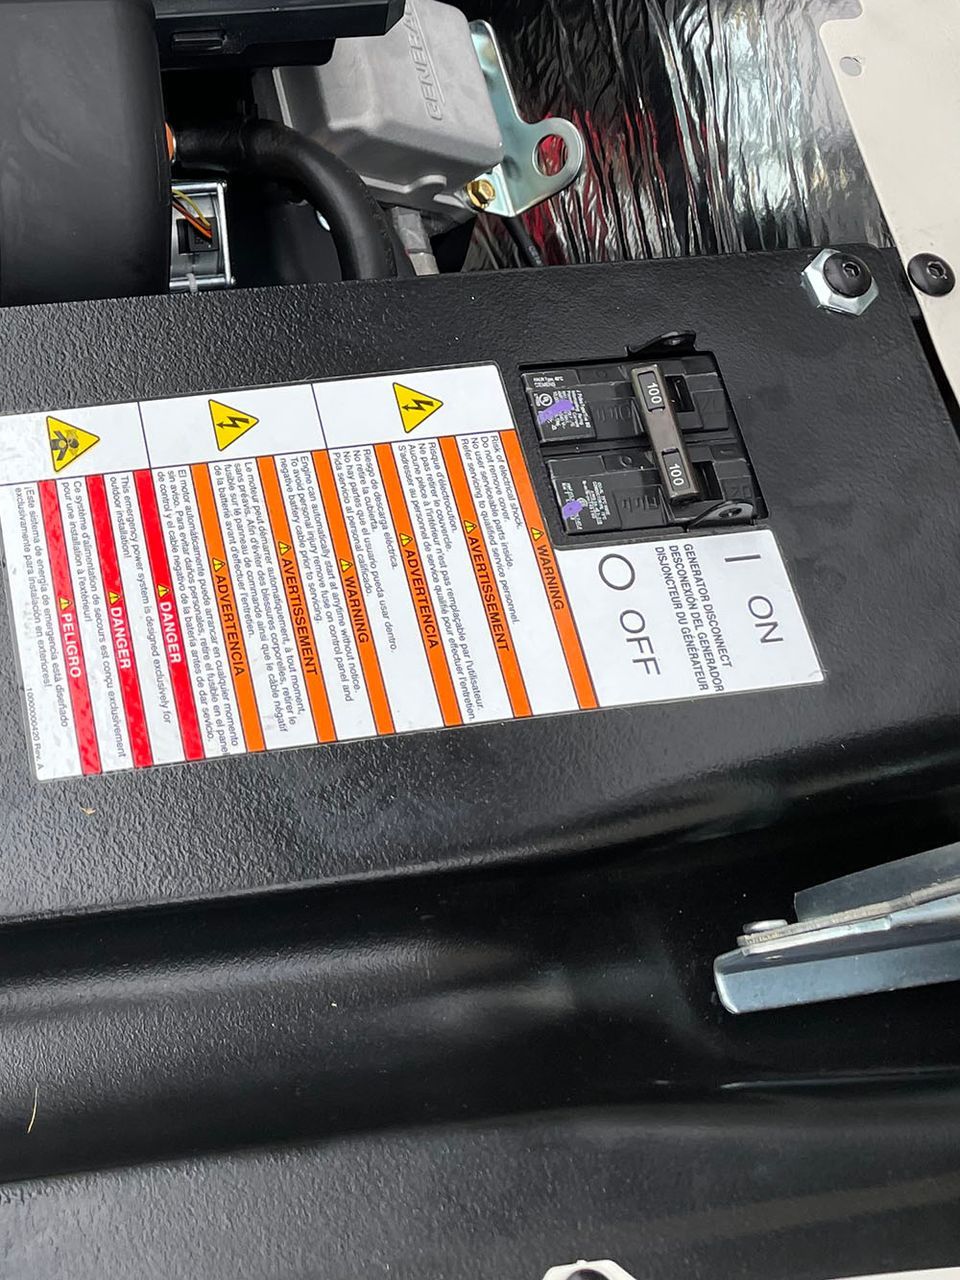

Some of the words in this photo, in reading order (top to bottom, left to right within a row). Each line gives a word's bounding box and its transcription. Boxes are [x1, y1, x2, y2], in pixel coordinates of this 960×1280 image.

[402, 3, 442, 121] GENERA
[647, 382, 662, 404] 100
[299, 455, 312, 484] Engine
[331, 451, 342, 471] Pida
[427, 441, 440, 470] Risque
[483, 449, 494, 463] not
[489, 434, 501, 453] Risk
[498, 464, 516, 501] electrical
[60, 481, 72, 500] pour
[120, 475, 130, 494] This
[246, 474, 259, 503] moteur
[279, 457, 293, 492] negative
[292, 467, 305, 491] avoid
[336, 472, 351, 504] servicio
[355, 463, 366, 485] retire
[362, 448, 375, 477] Riesgo
[372, 491, 388, 530] descarga
[419, 456, 431, 472] pas
[425, 473, 438, 498] retirer
[487, 464, 502, 495] remove
[669, 463, 685, 486] 100
[109, 476, 121, 508] outdoor
[287, 494, 300, 523] battery
[306, 485, 316, 502] can
[460, 438, 472, 460] Refer
[466, 462, 483, 498] servicing
[479, 510, 498, 546] qualified
[491, 547, 505, 578] service
[473, 450, 485, 469] user
[479, 470, 499, 517] serviceable
[491, 518, 505, 540] parts
[65, 500, 75, 519] une
[123, 495, 138, 542] emergency
[251, 505, 264, 524] peut
[296, 492, 314, 529] personal
[68, 521, 82, 566] installation
[294, 524, 307, 548] cable
[306, 530, 318, 554] injury
[310, 503, 330, 558] automatically
[346, 513, 364, 552] personal
[130, 543, 143, 571] power
[298, 549, 311, 570] prior
[312, 554, 325, 588] remove
[323, 560, 335, 580] start
[136, 572, 149, 604] system
[467, 536, 509, 650] AVERTISSEMENT
[536, 544, 564, 609] WARNING
[668, 544, 698, 610] DESCONEXIÓN
[179, 479, 190, 503] motor
[197, 578, 211, 606] puede
[204, 607, 218, 644] arrancar
[214, 659, 229, 701] cualquier
[223, 702, 238, 746] momento
[320, 589, 330, 609] fuse
[331, 592, 345, 627] anytime
[344, 575, 368, 642] WARNING
[404, 549, 438, 648] ADVERTENCIA
[682, 543, 710, 602] GENERATOR
[702, 603, 733, 667] DISCONNECT
[159, 601, 181, 662] DANGER
[215, 574, 244, 676] ADVERTENCIA
[281, 558, 317, 675] AVERTISSEMENT
[654, 546, 683, 609] DISJONCTEUR
[679, 626, 709, 691] GÉNÉRATEUR
[689, 611, 704, 631] DEL
[747, 595, 783, 643] ON
[61, 612, 81, 677] PELIGRO
[110, 606, 131, 668] DANGER
[144, 615, 160, 657] designed
[328, 624, 343, 655] control
[340, 628, 354, 661] without
[619, 609, 660, 674] OFF
[285, 654, 296, 672] tout
[333, 656, 349, 682] panel
[696, 631, 724, 692] GENERADOR
[93, 607, 105, 643] secours
[99, 644, 109, 659] est
[107, 690, 126, 757] exclusivement
[152, 658, 169, 708] exclusively
[341, 684, 354, 702] and
[162, 710, 171, 724] for
